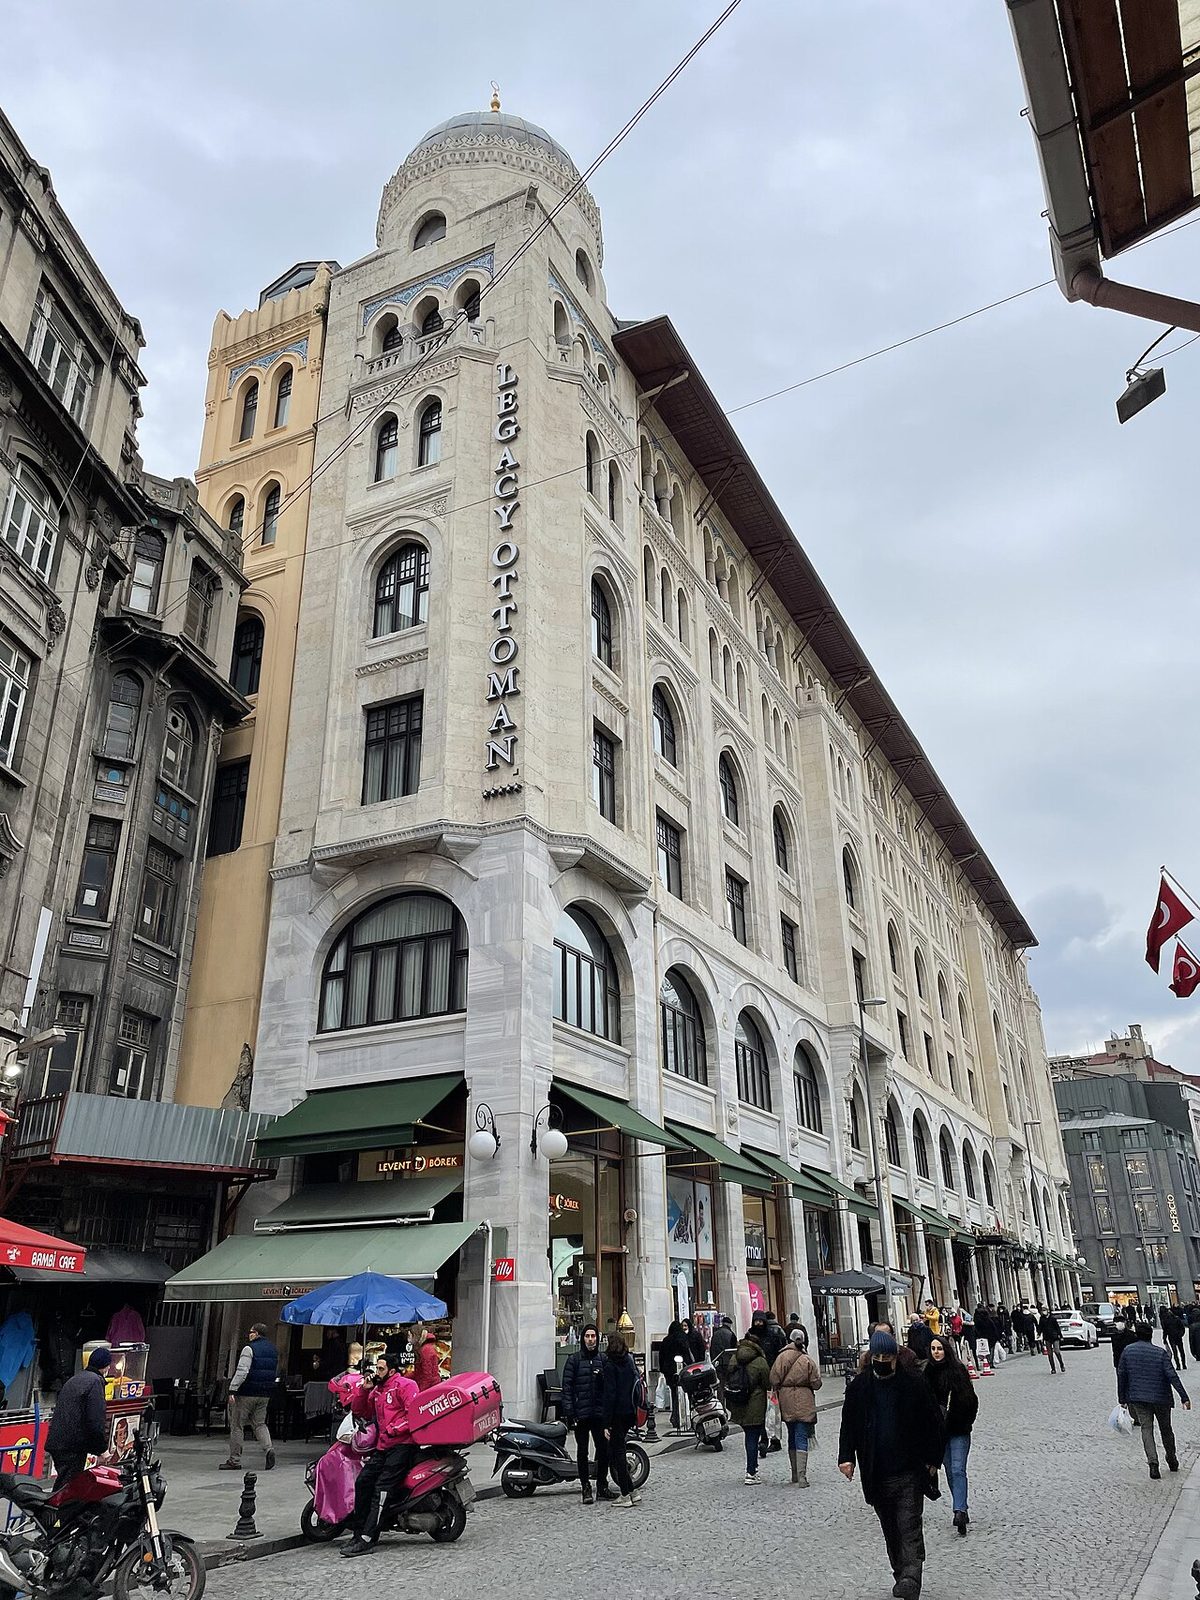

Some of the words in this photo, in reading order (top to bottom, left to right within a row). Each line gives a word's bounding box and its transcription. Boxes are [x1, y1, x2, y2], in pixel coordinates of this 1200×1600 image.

[494, 363, 520, 531] LEGACY
[485, 541, 520, 771] OTTOMAN
[378, 1161, 412, 1172] LEVENT
[429, 1156, 457, 1167] BÖREK
[59, 1256, 77, 1270] CAFE
[496, 1261, 513, 1279] illy
[829, 1287, 848, 1295] Coffee
[848, 1288, 864, 1296] Shop
[428, 1398, 451, 1417] VALE
